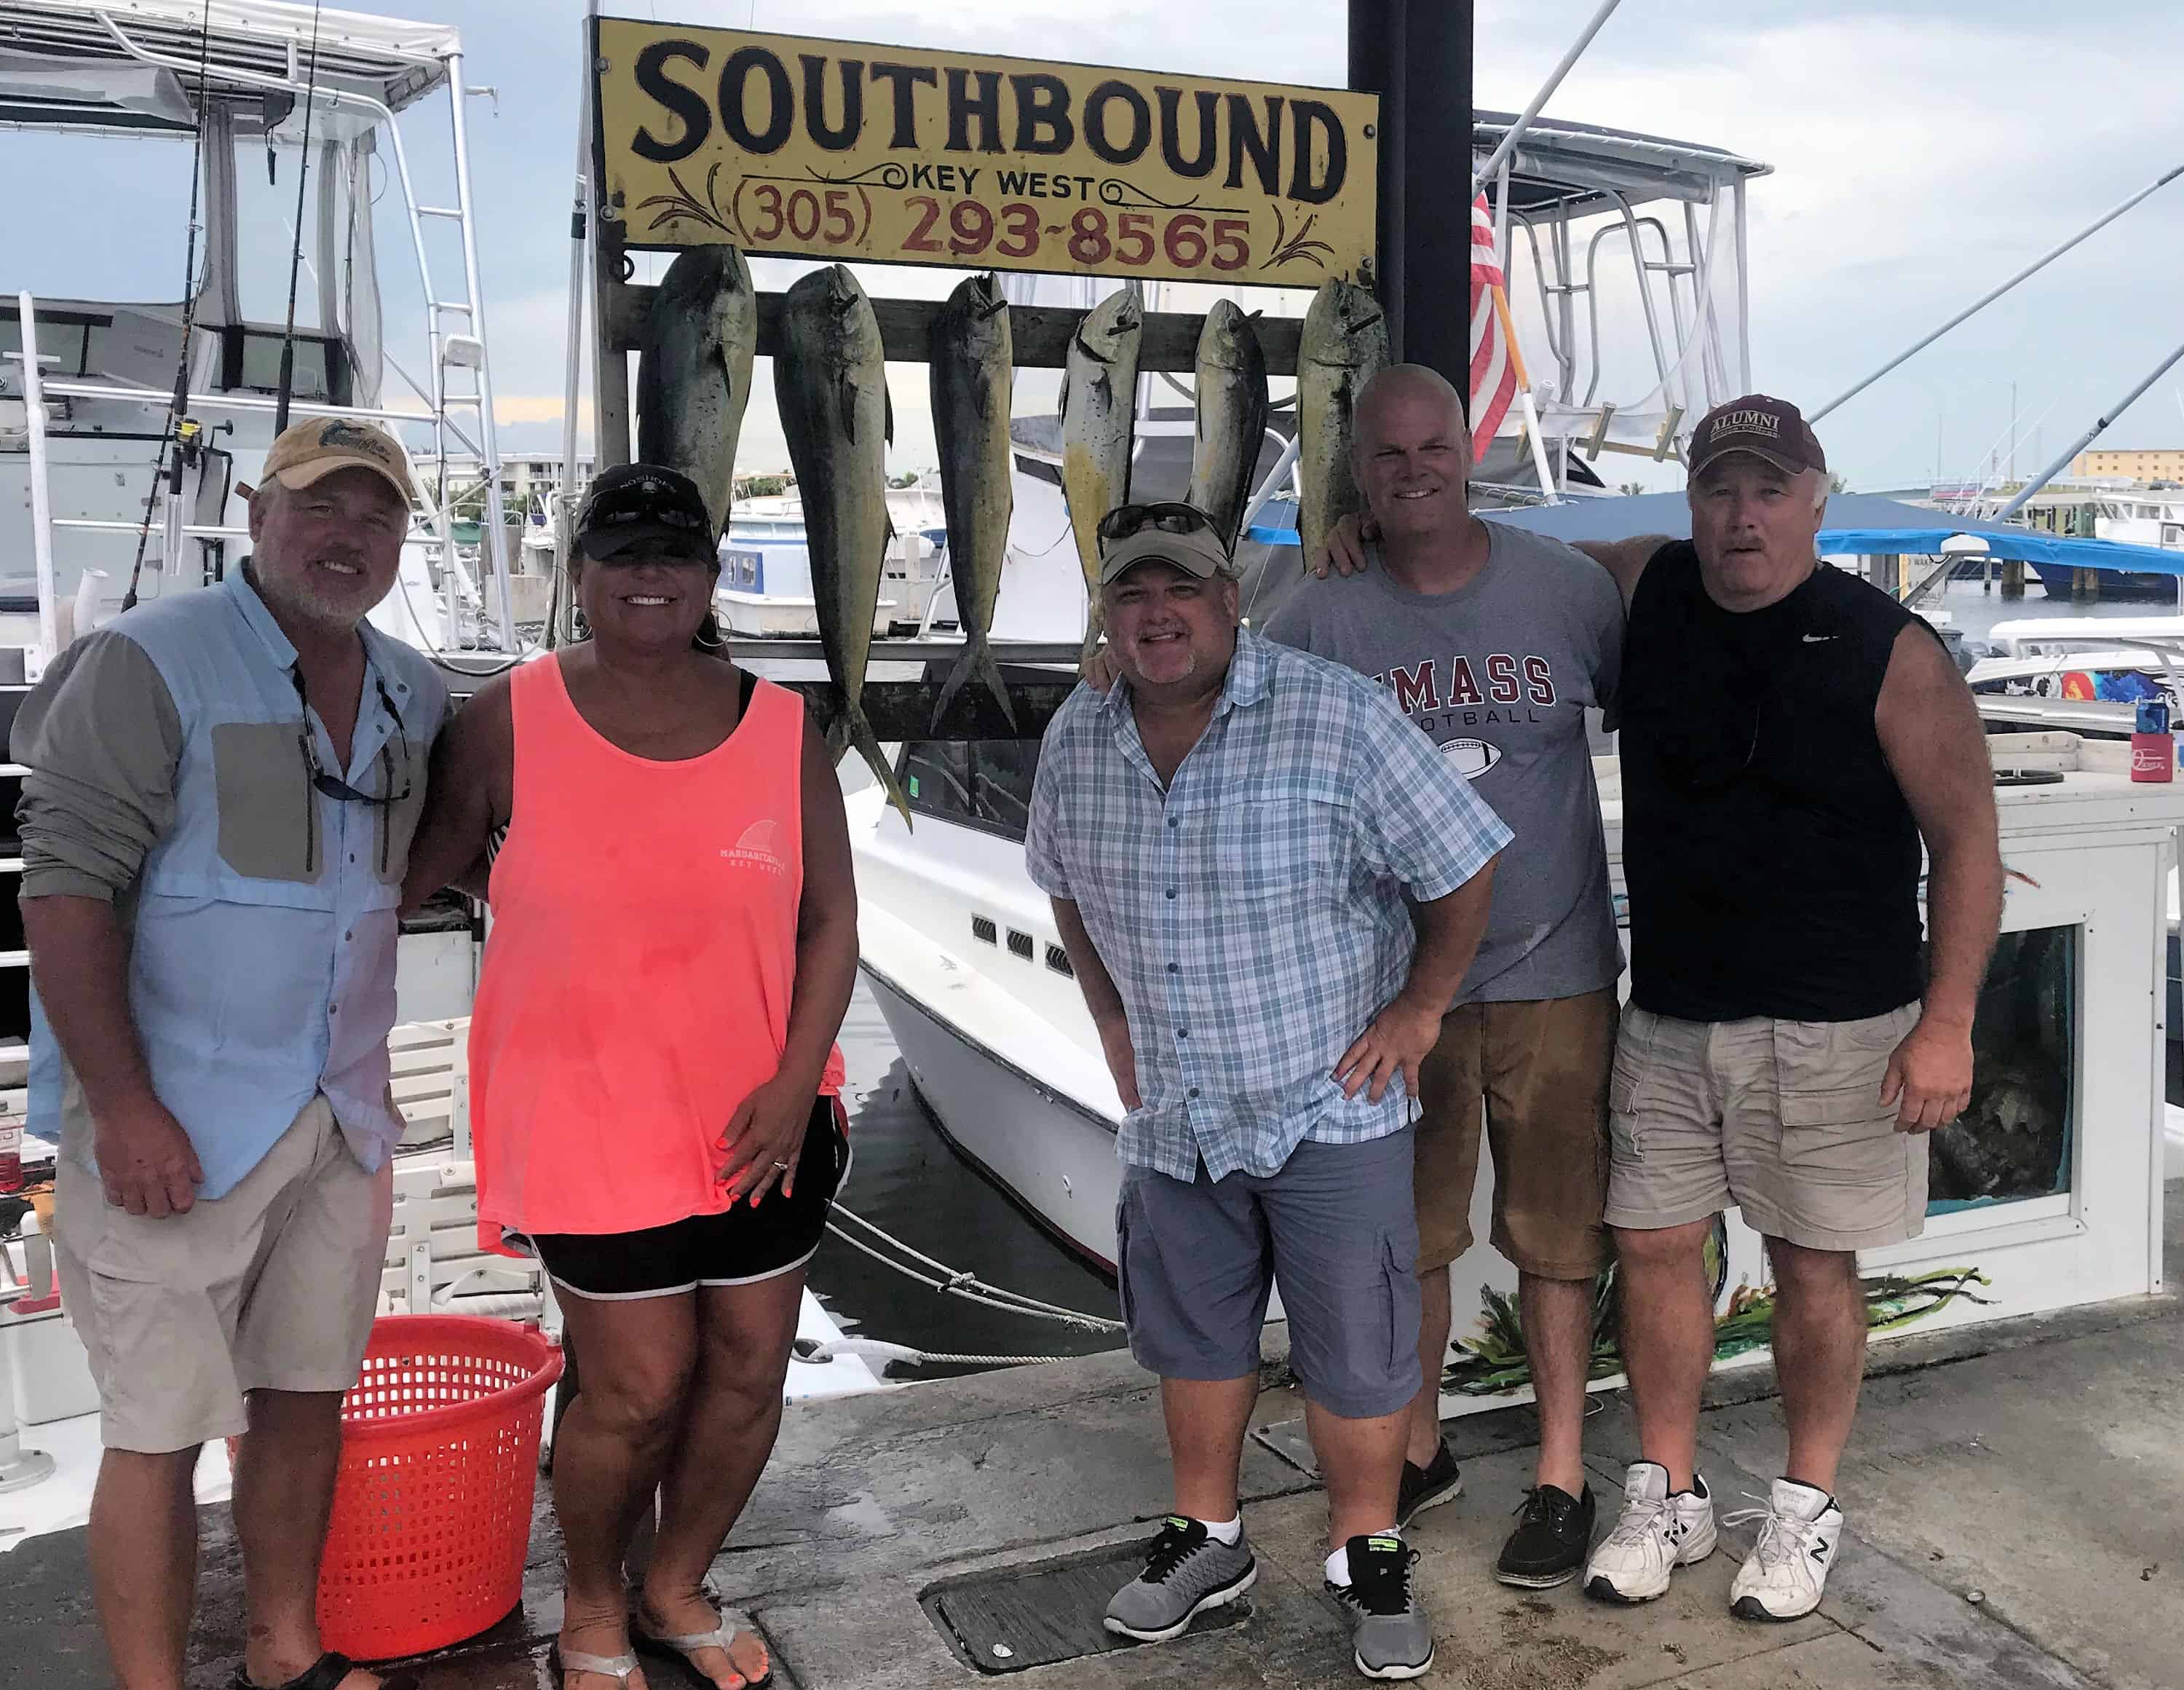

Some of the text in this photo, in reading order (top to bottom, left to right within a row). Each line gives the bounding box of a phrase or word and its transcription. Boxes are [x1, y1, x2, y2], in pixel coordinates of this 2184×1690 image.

[630, 38, 1348, 205] SOUTHBOUND
[911, 162, 1096, 201] KEY WEST
[732, 178, 872, 246] (305)
[1711, 411, 1781, 433] ALUMNI
[1372, 653, 1556, 716] MASS
[1420, 708, 1540, 732] OTBALL
